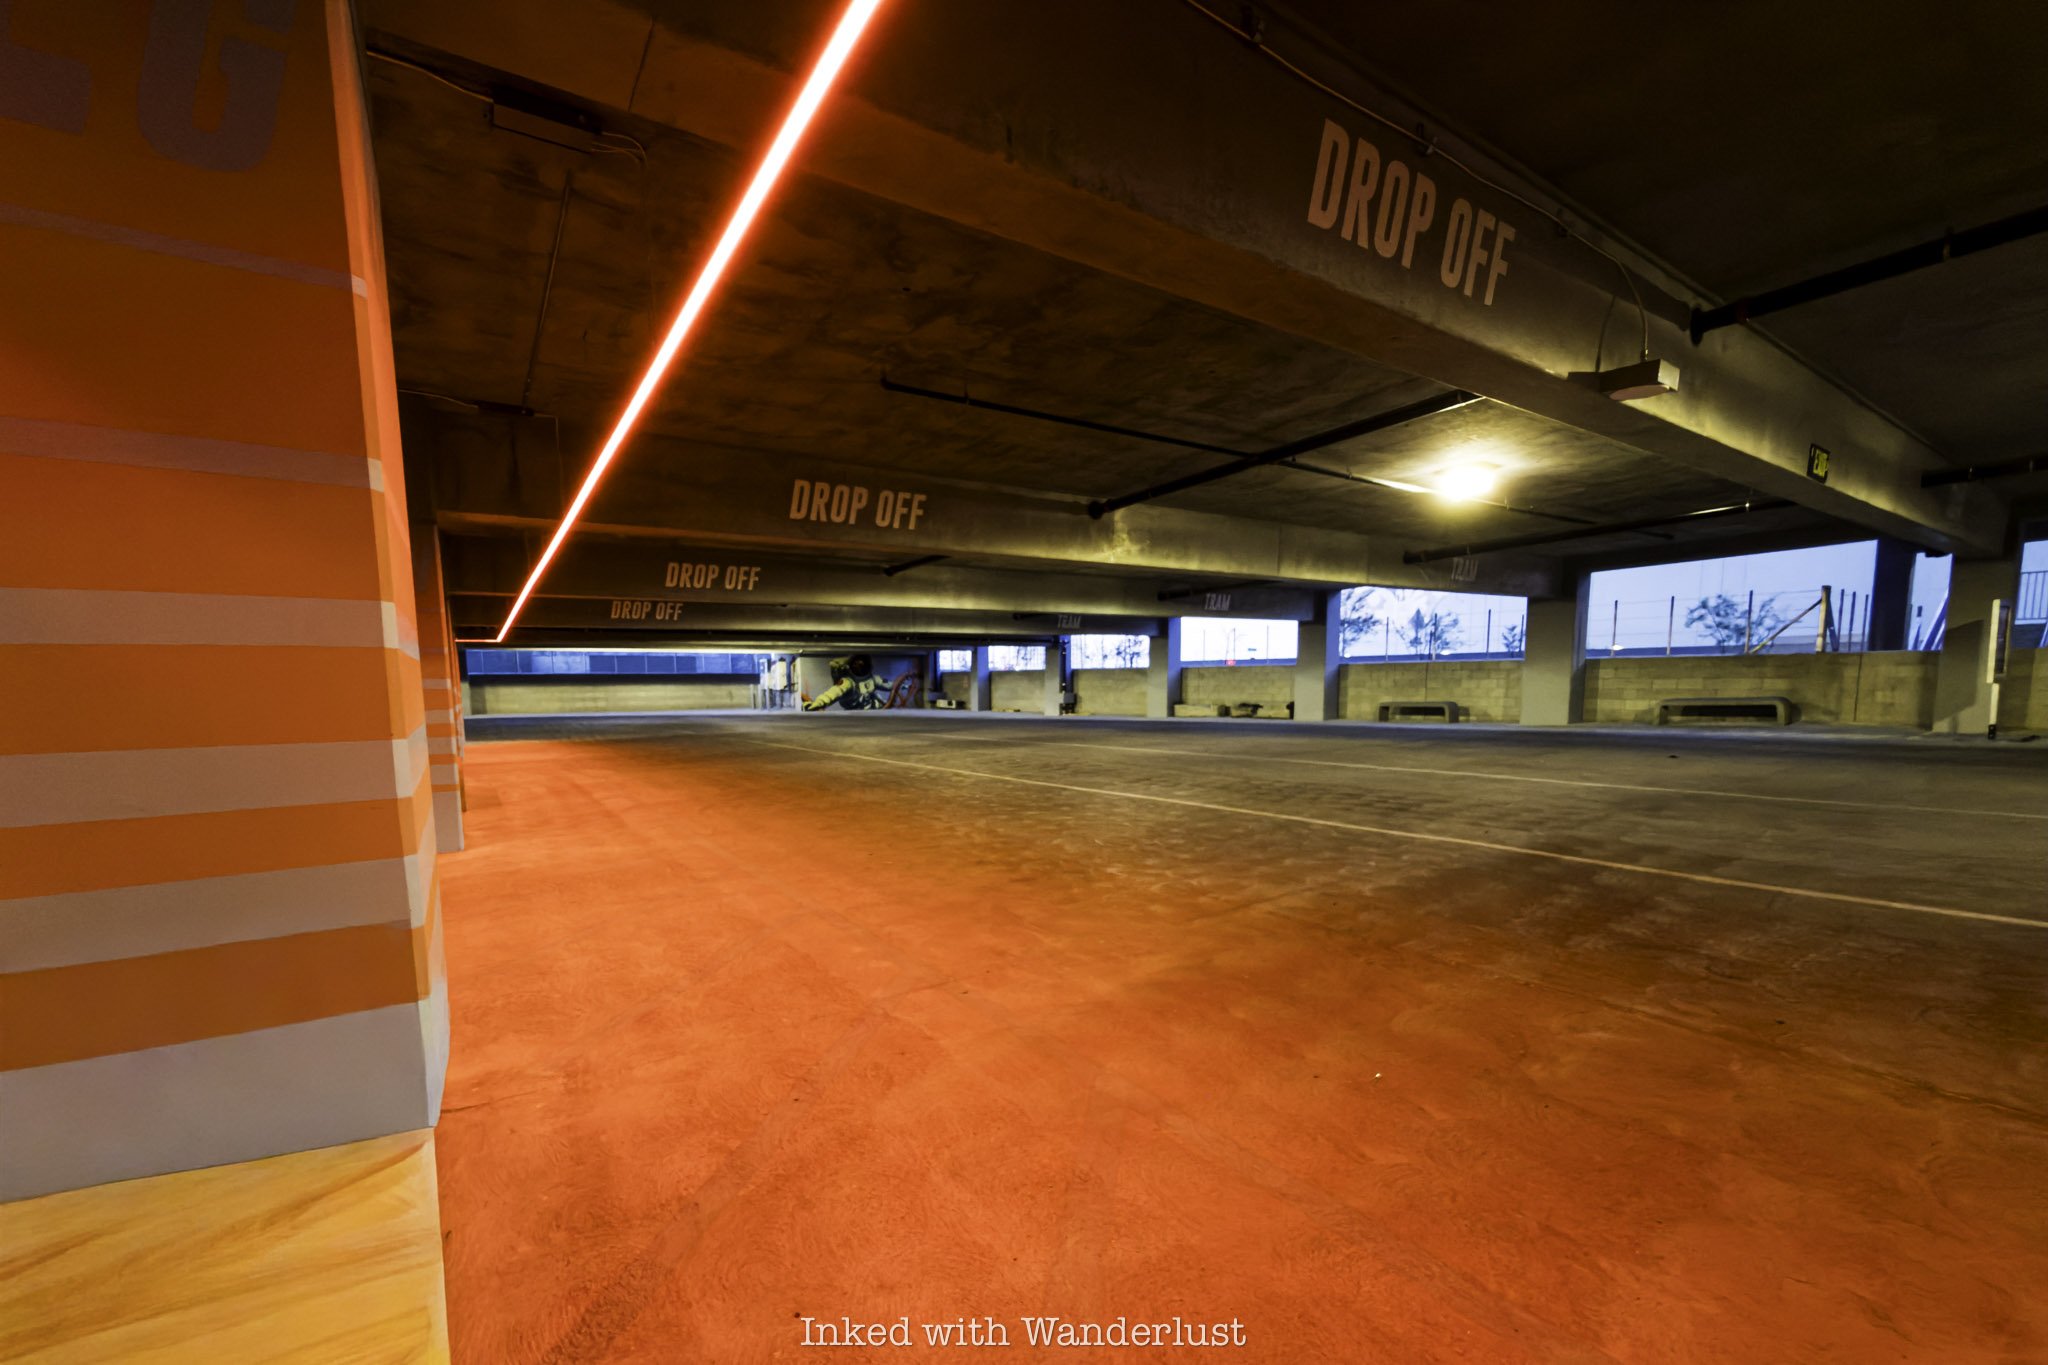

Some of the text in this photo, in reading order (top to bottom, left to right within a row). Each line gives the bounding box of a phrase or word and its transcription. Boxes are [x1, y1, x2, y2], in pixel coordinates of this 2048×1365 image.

[1307, 118, 1516, 306] DROP OFF
[789, 479, 927, 530] DROP OFF
[665, 562, 762, 591] DROP OFF
[610, 600, 684, 621] DROP OFF
[1204, 592, 1232, 612] TRAM
